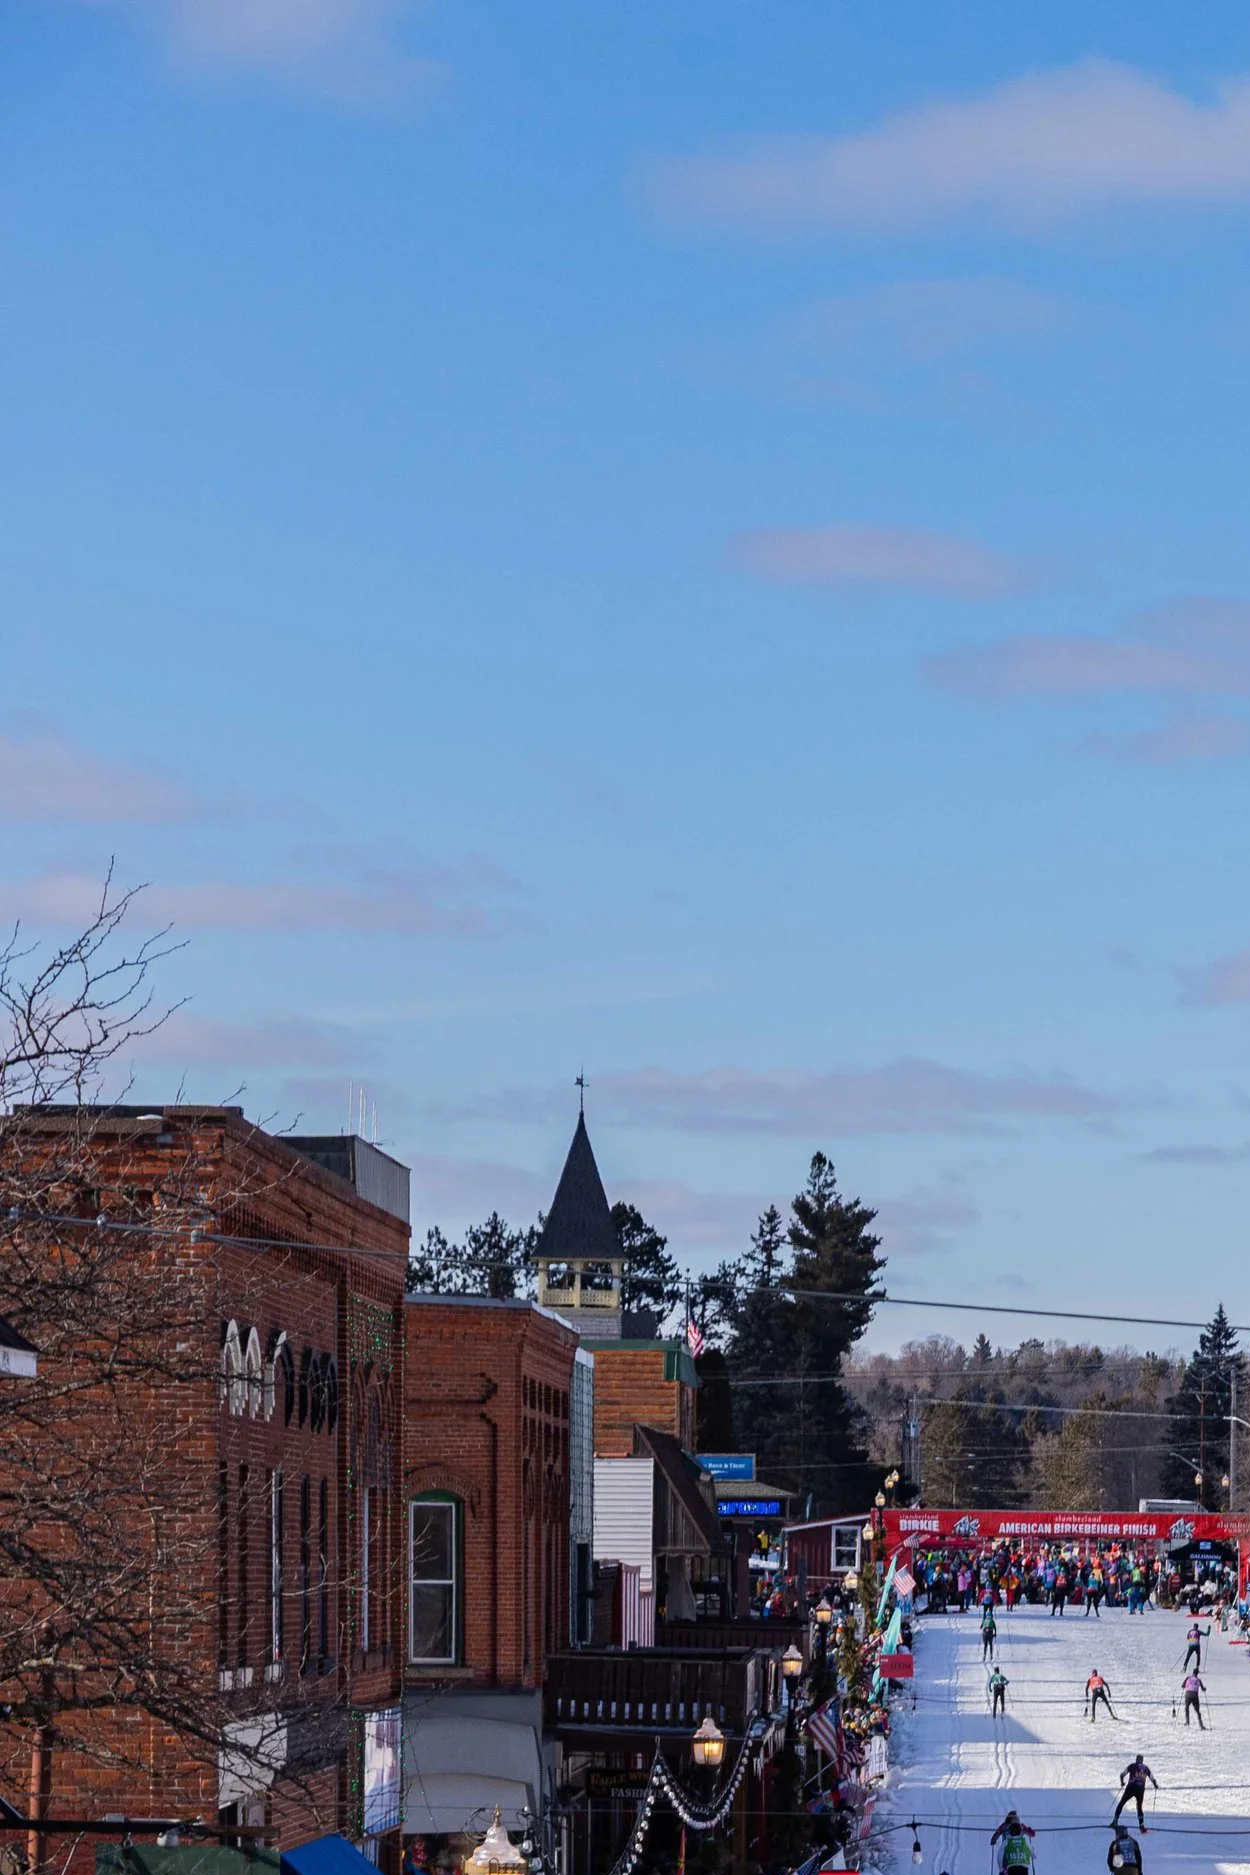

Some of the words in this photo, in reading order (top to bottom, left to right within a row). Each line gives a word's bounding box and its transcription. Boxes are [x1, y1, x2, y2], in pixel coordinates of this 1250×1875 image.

[899, 1519, 940, 1532] BIRKIE
[998, 1522, 1051, 1534] AMERICAN
[1053, 1523, 1121, 1535] BIRKEBEINER
[1122, 1524, 1157, 1536] FINISH
